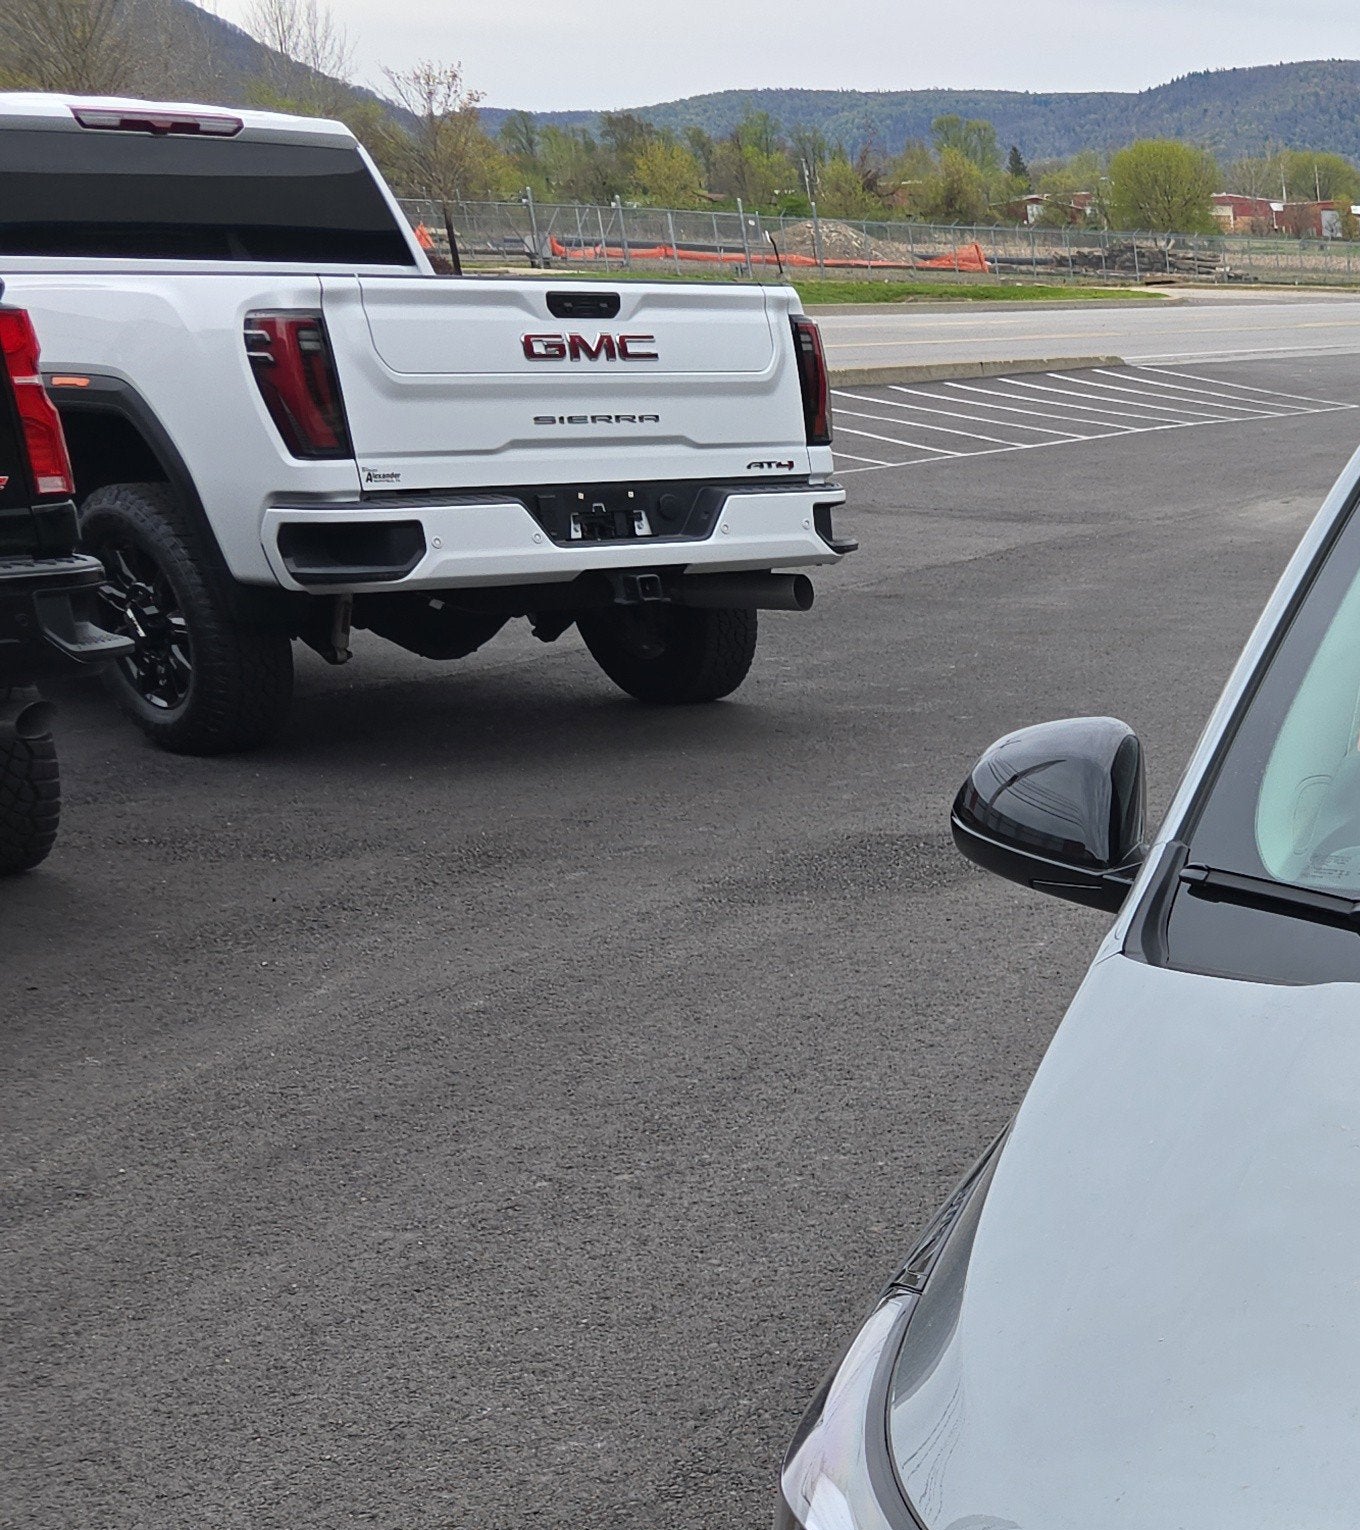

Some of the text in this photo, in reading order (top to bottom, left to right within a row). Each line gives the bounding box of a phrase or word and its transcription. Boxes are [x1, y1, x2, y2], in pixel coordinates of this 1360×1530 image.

[520, 332, 659, 362] GMC
[533, 414, 660, 425] SIERRA
[746, 460, 795, 471] AT4
